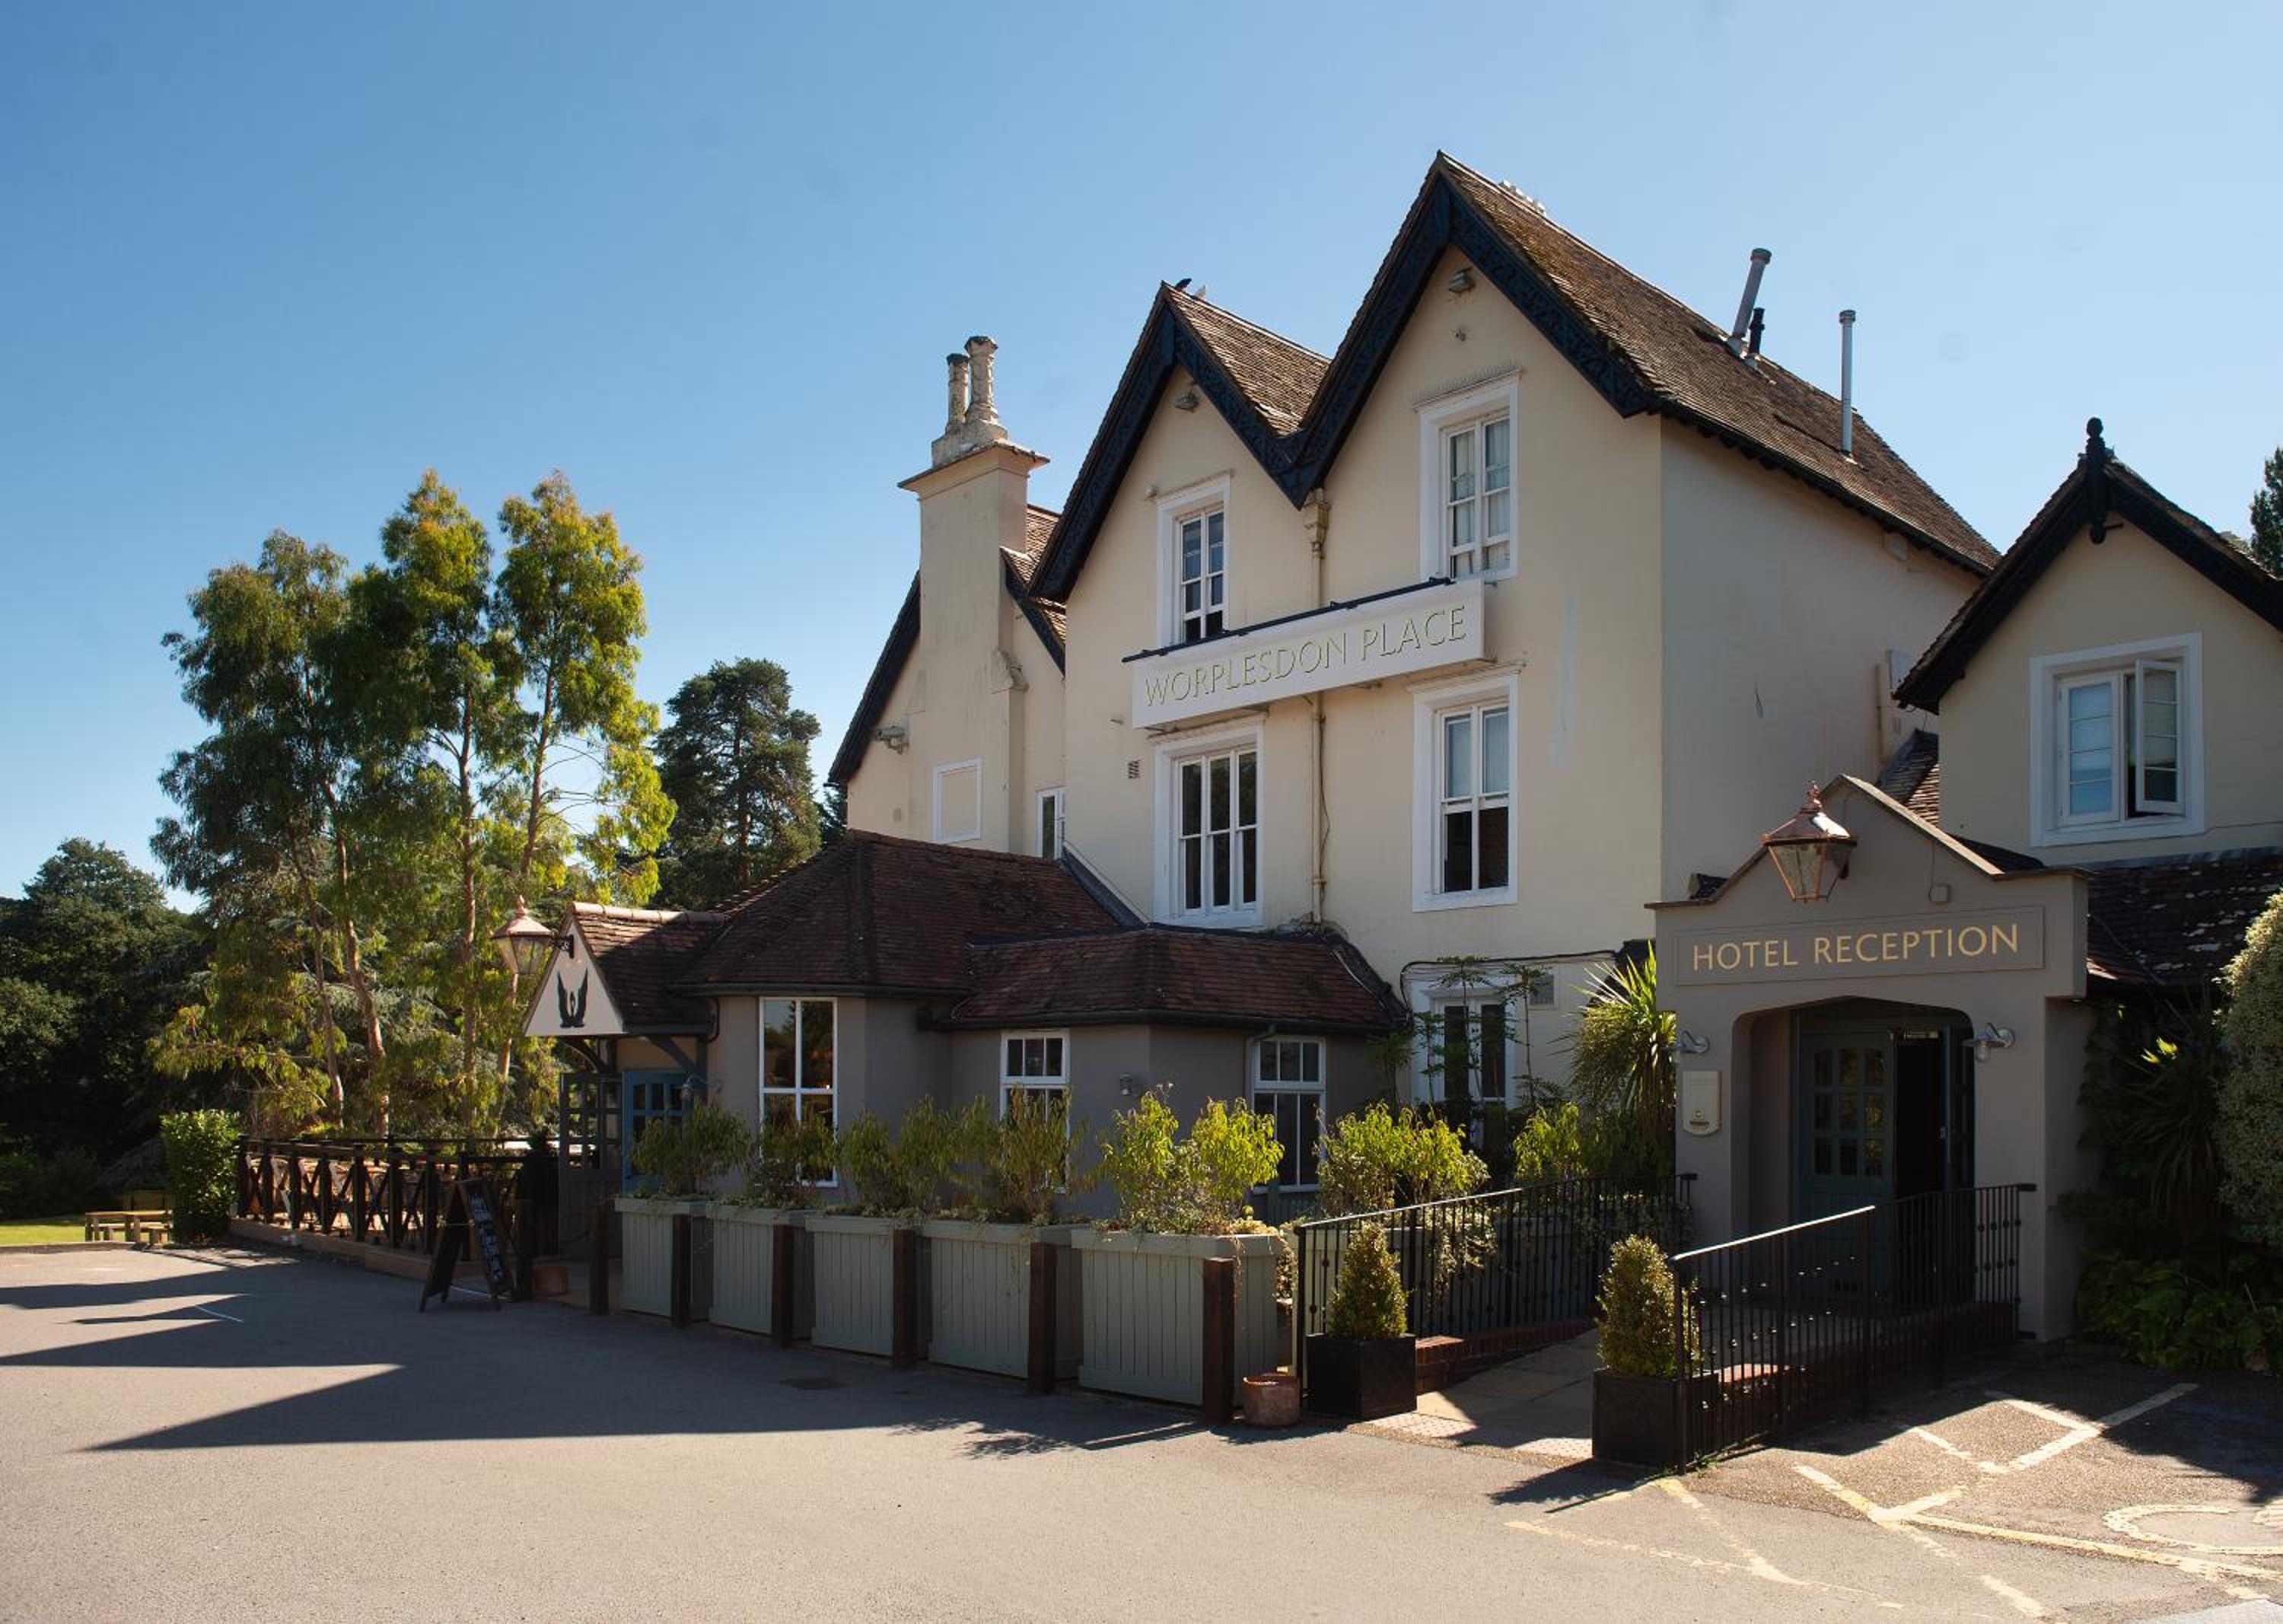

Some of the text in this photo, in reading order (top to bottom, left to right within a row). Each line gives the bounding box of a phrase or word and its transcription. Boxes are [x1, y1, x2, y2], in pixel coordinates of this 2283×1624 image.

[1144, 605, 1466, 707] WORPLESDON PLACE
[1692, 923, 2018, 971] HOTEL RECEPTION
